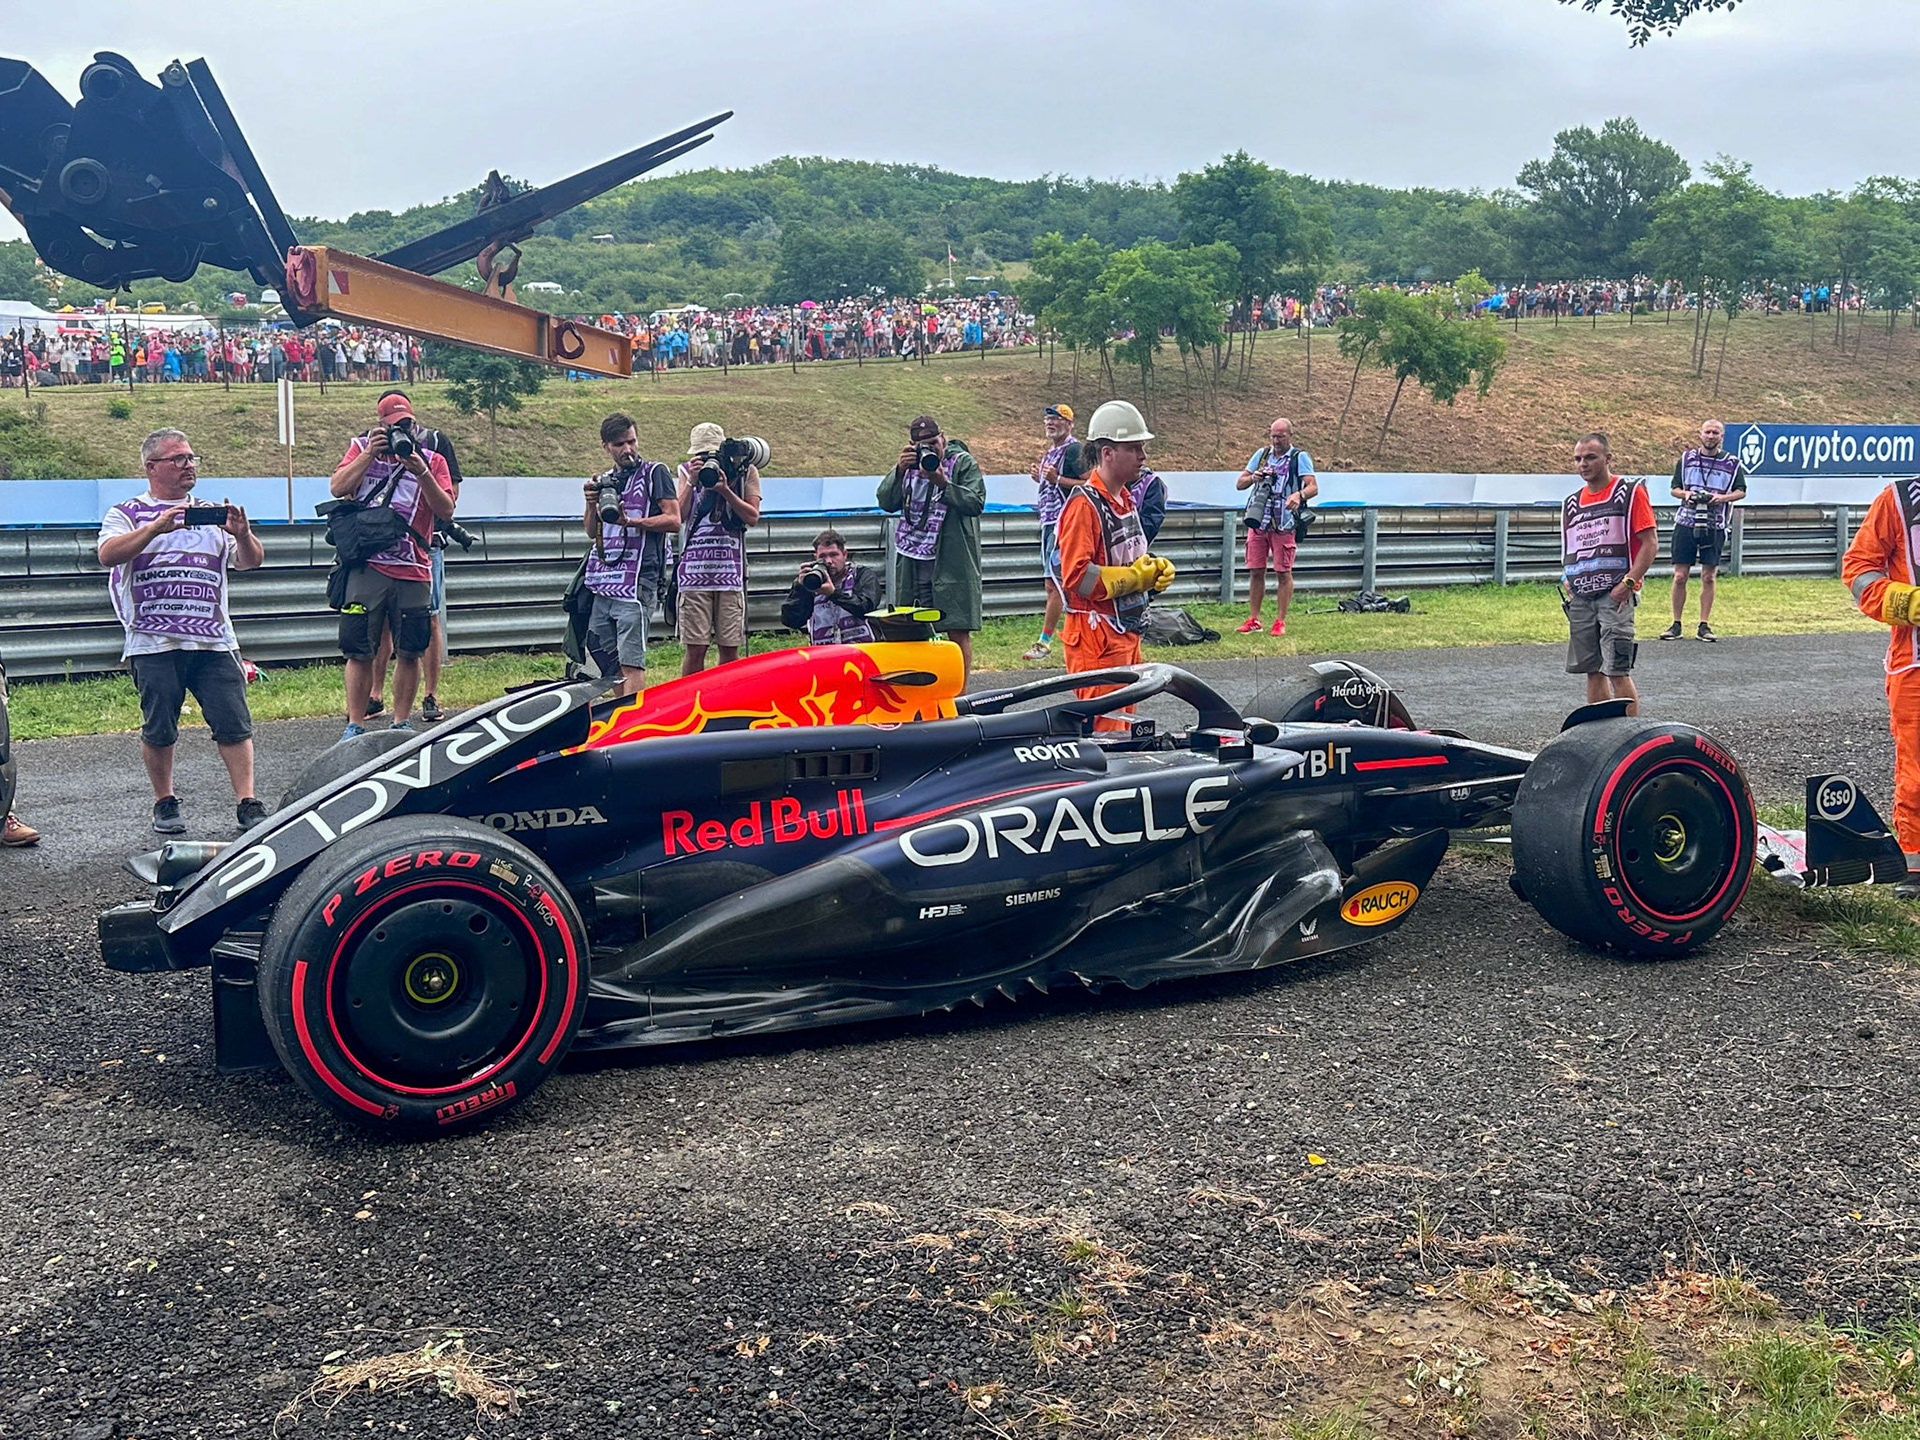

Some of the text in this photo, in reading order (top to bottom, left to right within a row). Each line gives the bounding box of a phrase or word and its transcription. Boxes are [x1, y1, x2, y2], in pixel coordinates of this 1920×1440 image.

[1773, 430, 1914, 469] crypto.com
[1576, 529, 1610, 542] BOUNDARY
[1582, 538, 1600, 547] RIDER
[193, 556, 209, 566] FIA
[1574, 573, 1612, 586] COURSE
[163, 584, 217, 599] MEDIA
[141, 602, 212, 613] PHOTOGRAPHER
[1331, 683, 1358, 697] Hard
[1314, 695, 1327, 711] P
[1013, 741, 1081, 763] ROKT
[1695, 736, 1736, 774] PIRELLI
[208, 690, 572, 900] ORACLE
[1823, 788, 1851, 807] Esso
[469, 806, 607, 833] ONDA
[661, 788, 868, 856] Red Bull
[899, 776, 1230, 867] ORACLE
[321, 894, 342, 927] P
[353, 850, 482, 897] ZERO
[1005, 887, 1061, 907] SIEMENS
[1361, 890, 1410, 914] RAUCH
[1603, 887, 1693, 944] P ZERO
[436, 1081, 517, 1124] PIRELLI
